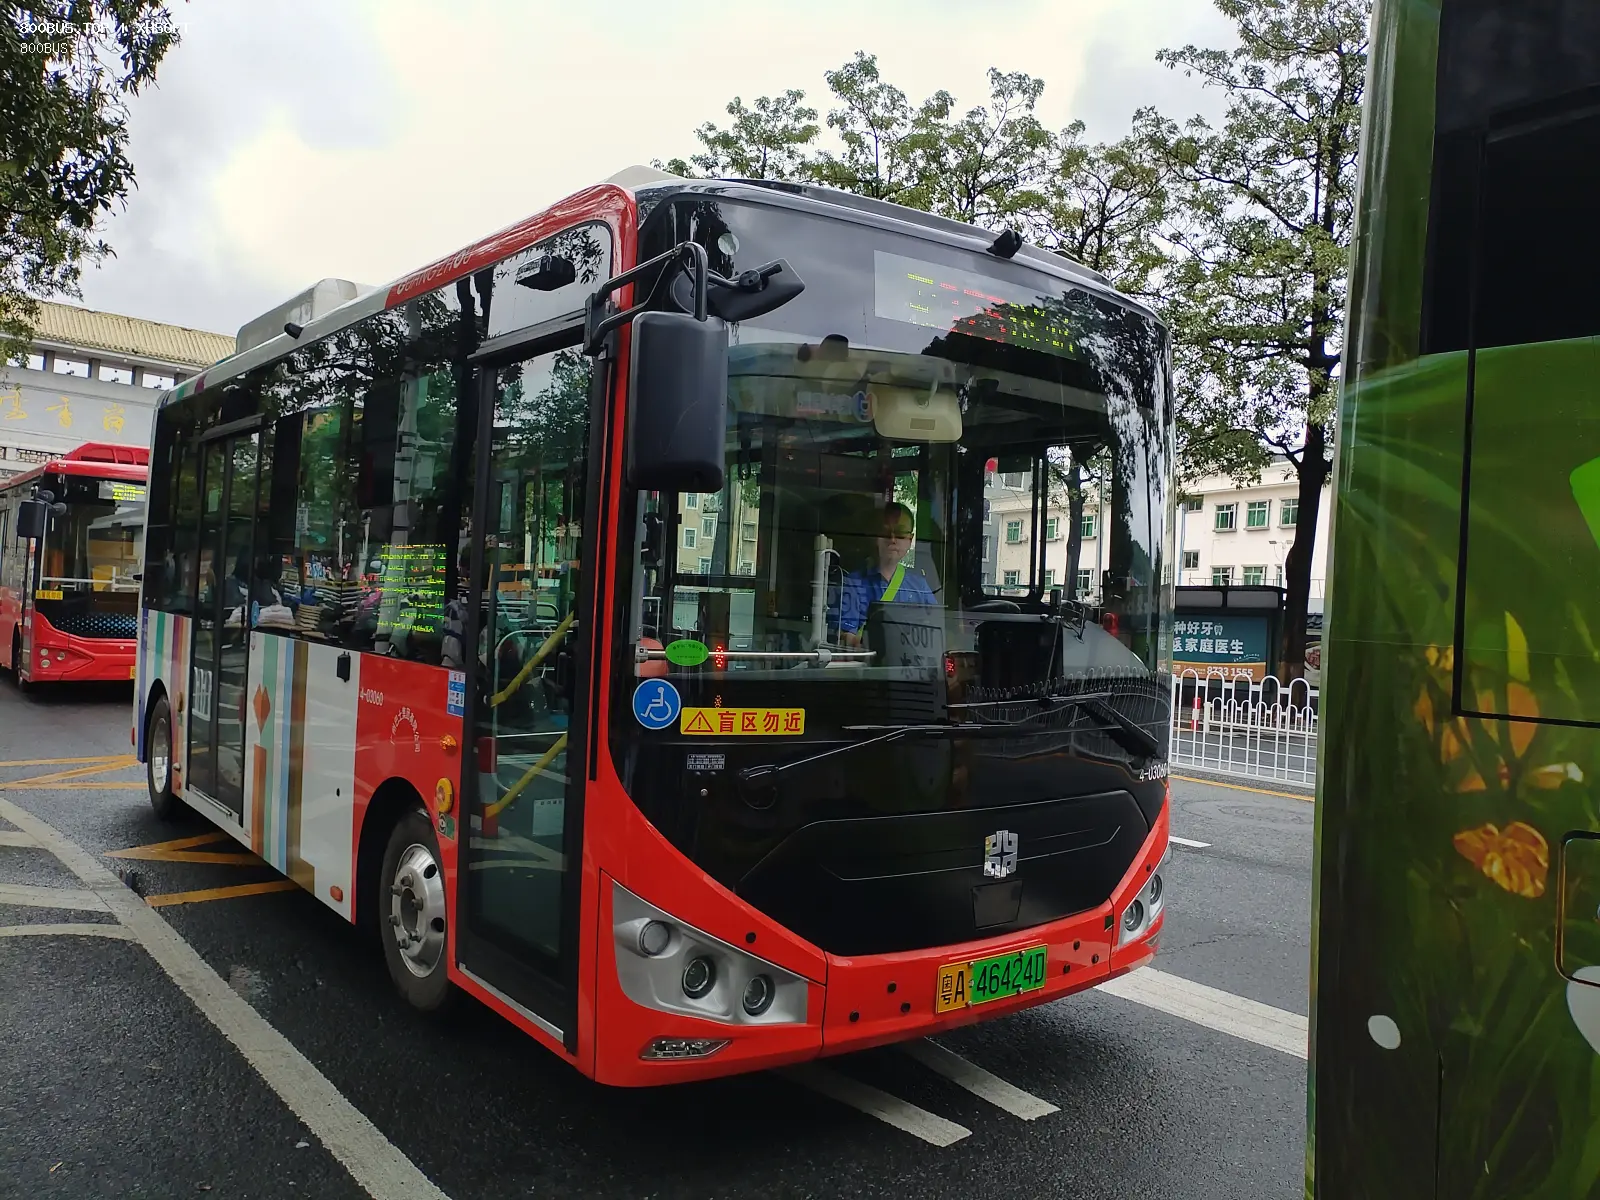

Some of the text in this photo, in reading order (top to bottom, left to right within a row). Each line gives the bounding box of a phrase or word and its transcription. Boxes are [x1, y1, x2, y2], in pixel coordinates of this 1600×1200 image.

[1174, 621, 1213, 636] 种好牙
[718, 711, 801, 733] 盲区勿近
[976, 952, 1045, 997] 46424D
